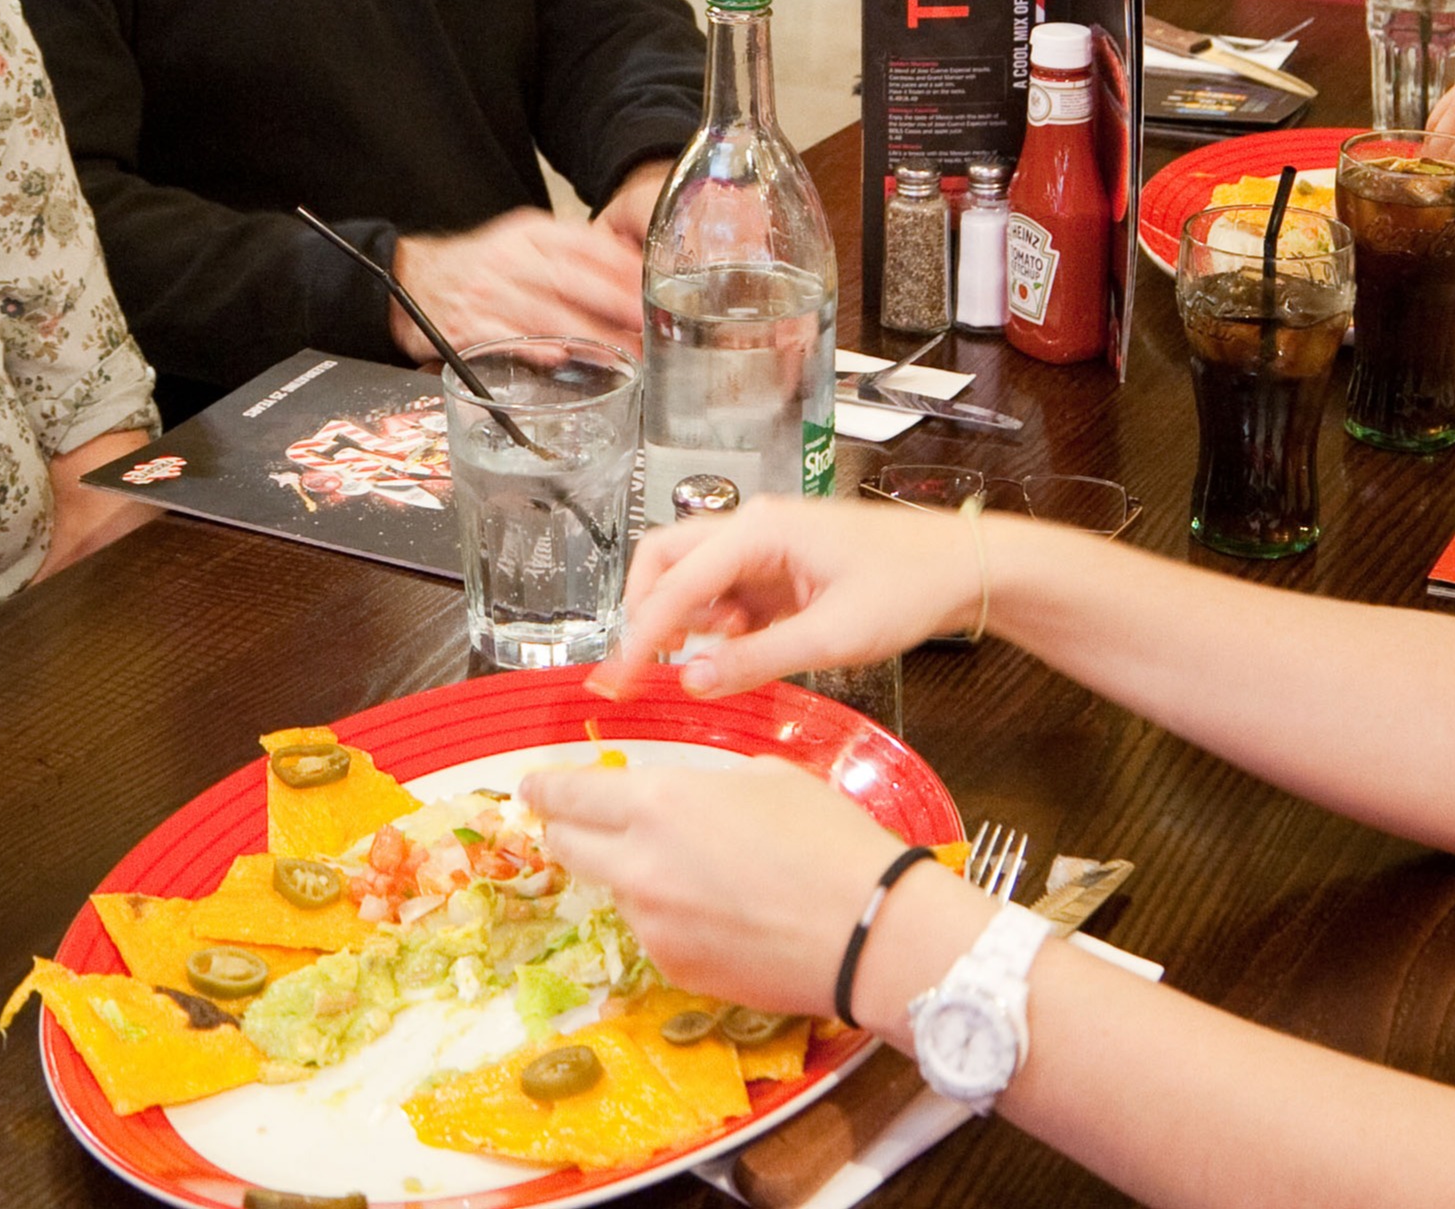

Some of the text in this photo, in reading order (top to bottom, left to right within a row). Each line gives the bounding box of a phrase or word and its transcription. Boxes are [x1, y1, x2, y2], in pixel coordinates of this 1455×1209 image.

[1013, 18, 1029, 42] MIX
[1013, 44, 1029, 78] COOL
[1013, 79, 1027, 89] A
[805, 434, 835, 481] Strat
